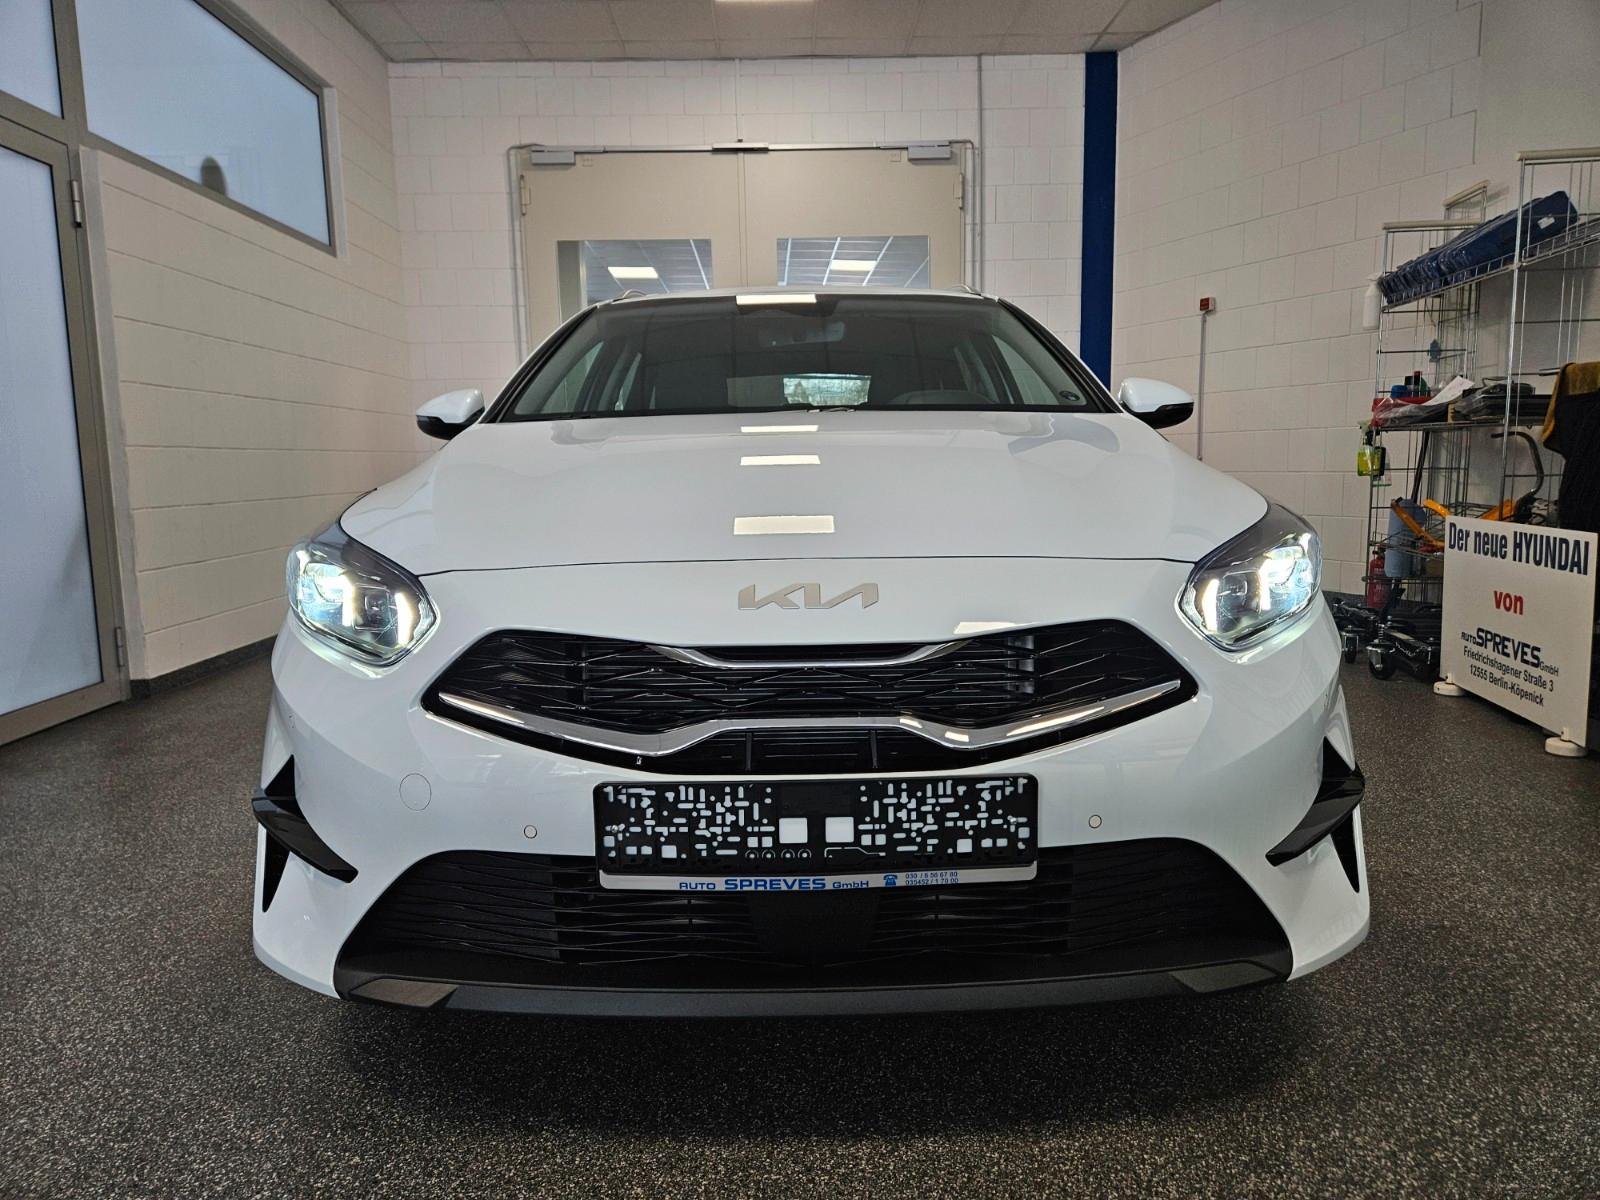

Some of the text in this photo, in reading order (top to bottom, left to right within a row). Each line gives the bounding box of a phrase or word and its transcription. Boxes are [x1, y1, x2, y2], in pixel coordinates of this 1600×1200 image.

[1448, 522, 1590, 576] Der neue HYUNDAI
[738, 582, 879, 610] KIA
[1493, 590, 1524, 615] von
[1463, 645, 1554, 692] Friedrichshagener Straße 3
[1476, 627, 1541, 669] SPREVES
[1540, 661, 1560, 677] GmbH
[1470, 663, 1544, 706] 12555 Berlin-Köpenick
[679, 878, 870, 891] AUTO SPREVES GmbH
